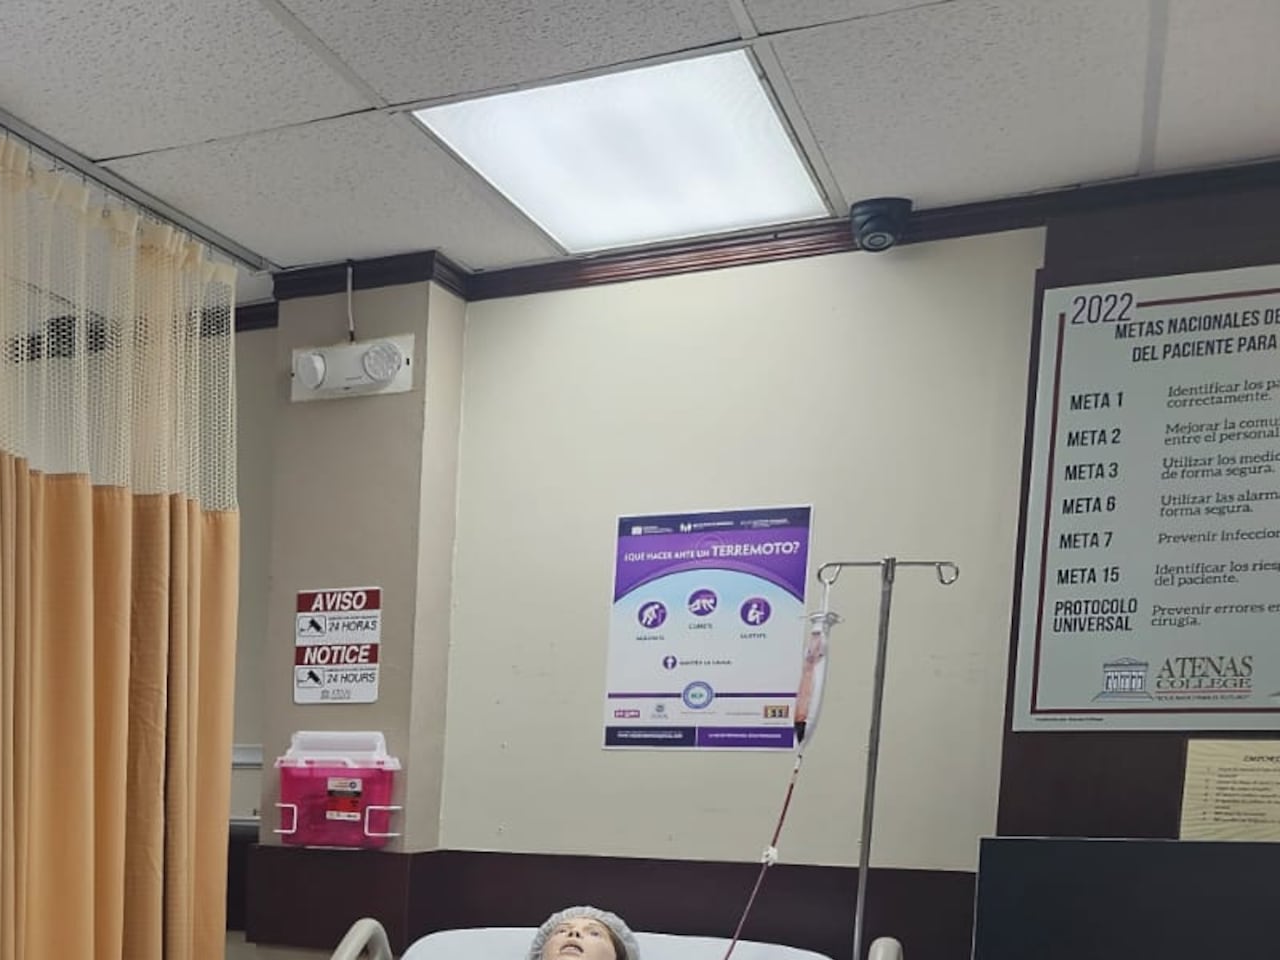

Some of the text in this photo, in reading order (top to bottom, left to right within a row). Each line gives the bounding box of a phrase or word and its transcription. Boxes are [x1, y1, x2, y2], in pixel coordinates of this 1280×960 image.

[1071, 293, 1134, 324] 2022
[1115, 319, 1165, 339] METAS
[1167, 310, 1260, 334] NACIONALES
[1132, 334, 1277, 362] DEL PACIENTE PARA
[1168, 381, 1241, 397] Identificar
[1243, 379, 1264, 391] los
[1070, 392, 1124, 410] META 1
[1167, 392, 1272, 408] correctamente.
[1165, 422, 1220, 434] Mejorar
[1224, 418, 1236, 430] la
[1067, 429, 1121, 446] META 2
[1164, 427, 1280, 445] entre el personal
[1162, 455, 1213, 469] Utilizar
[1217, 453, 1236, 465] los
[1065, 463, 1118, 480] META 3
[1161, 464, 1275, 479] de forma segura.
[1062, 496, 1116, 514] META 6
[1161, 489, 1280, 506] Utilizar las alarm
[1160, 504, 1253, 517] forma segura.
[1059, 531, 1113, 549] META 7
[1159, 531, 1217, 544] Prevenir
[710, 541, 801, 556] TERREMOTO?
[1057, 567, 1119, 584] META 15
[1155, 562, 1227, 575] Identificar
[1230, 561, 1249, 572] los
[1155, 574, 1240, 587] del paciente.
[311, 591, 367, 612] AVISO
[1054, 598, 1138, 616] PROTOCOLO
[1152, 603, 1212, 616] Prevenir
[1214, 604, 1265, 614] errores
[328, 620, 377, 632] 24 HORAS
[1053, 616, 1133, 632] UNIVERSAL
[304, 644, 371, 665] NOTICE
[1156, 655, 1253, 679] ATENAS
[327, 672, 376, 684] 24 HOURS
[1156, 679, 1252, 689] COLLEGE
